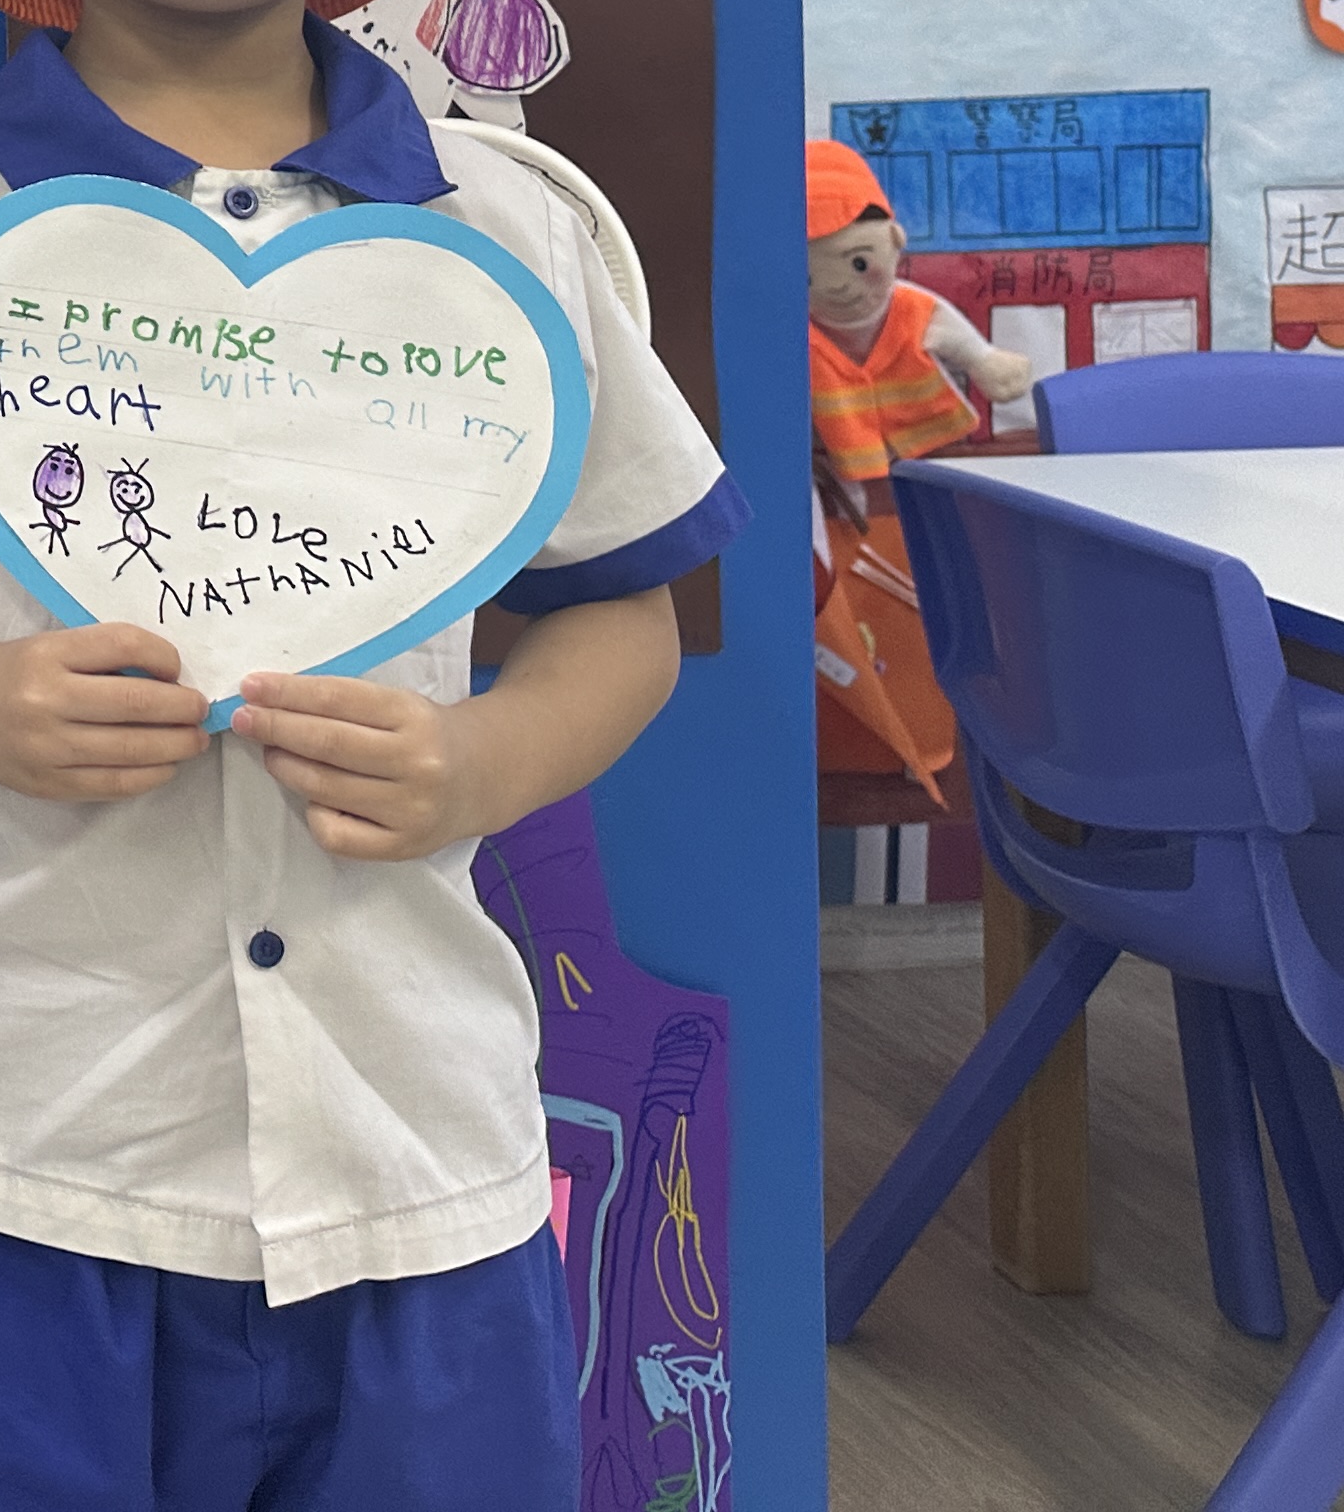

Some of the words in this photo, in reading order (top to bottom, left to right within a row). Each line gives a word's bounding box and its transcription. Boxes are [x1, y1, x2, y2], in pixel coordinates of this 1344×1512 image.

[965, 99, 1085, 148] 警察局
[974, 247, 1116, 300] 消防局
[8, 297, 44, 322] I
[63, 298, 276, 366] promise
[199, 363, 317, 399] with
[463, 413, 528, 463] my
